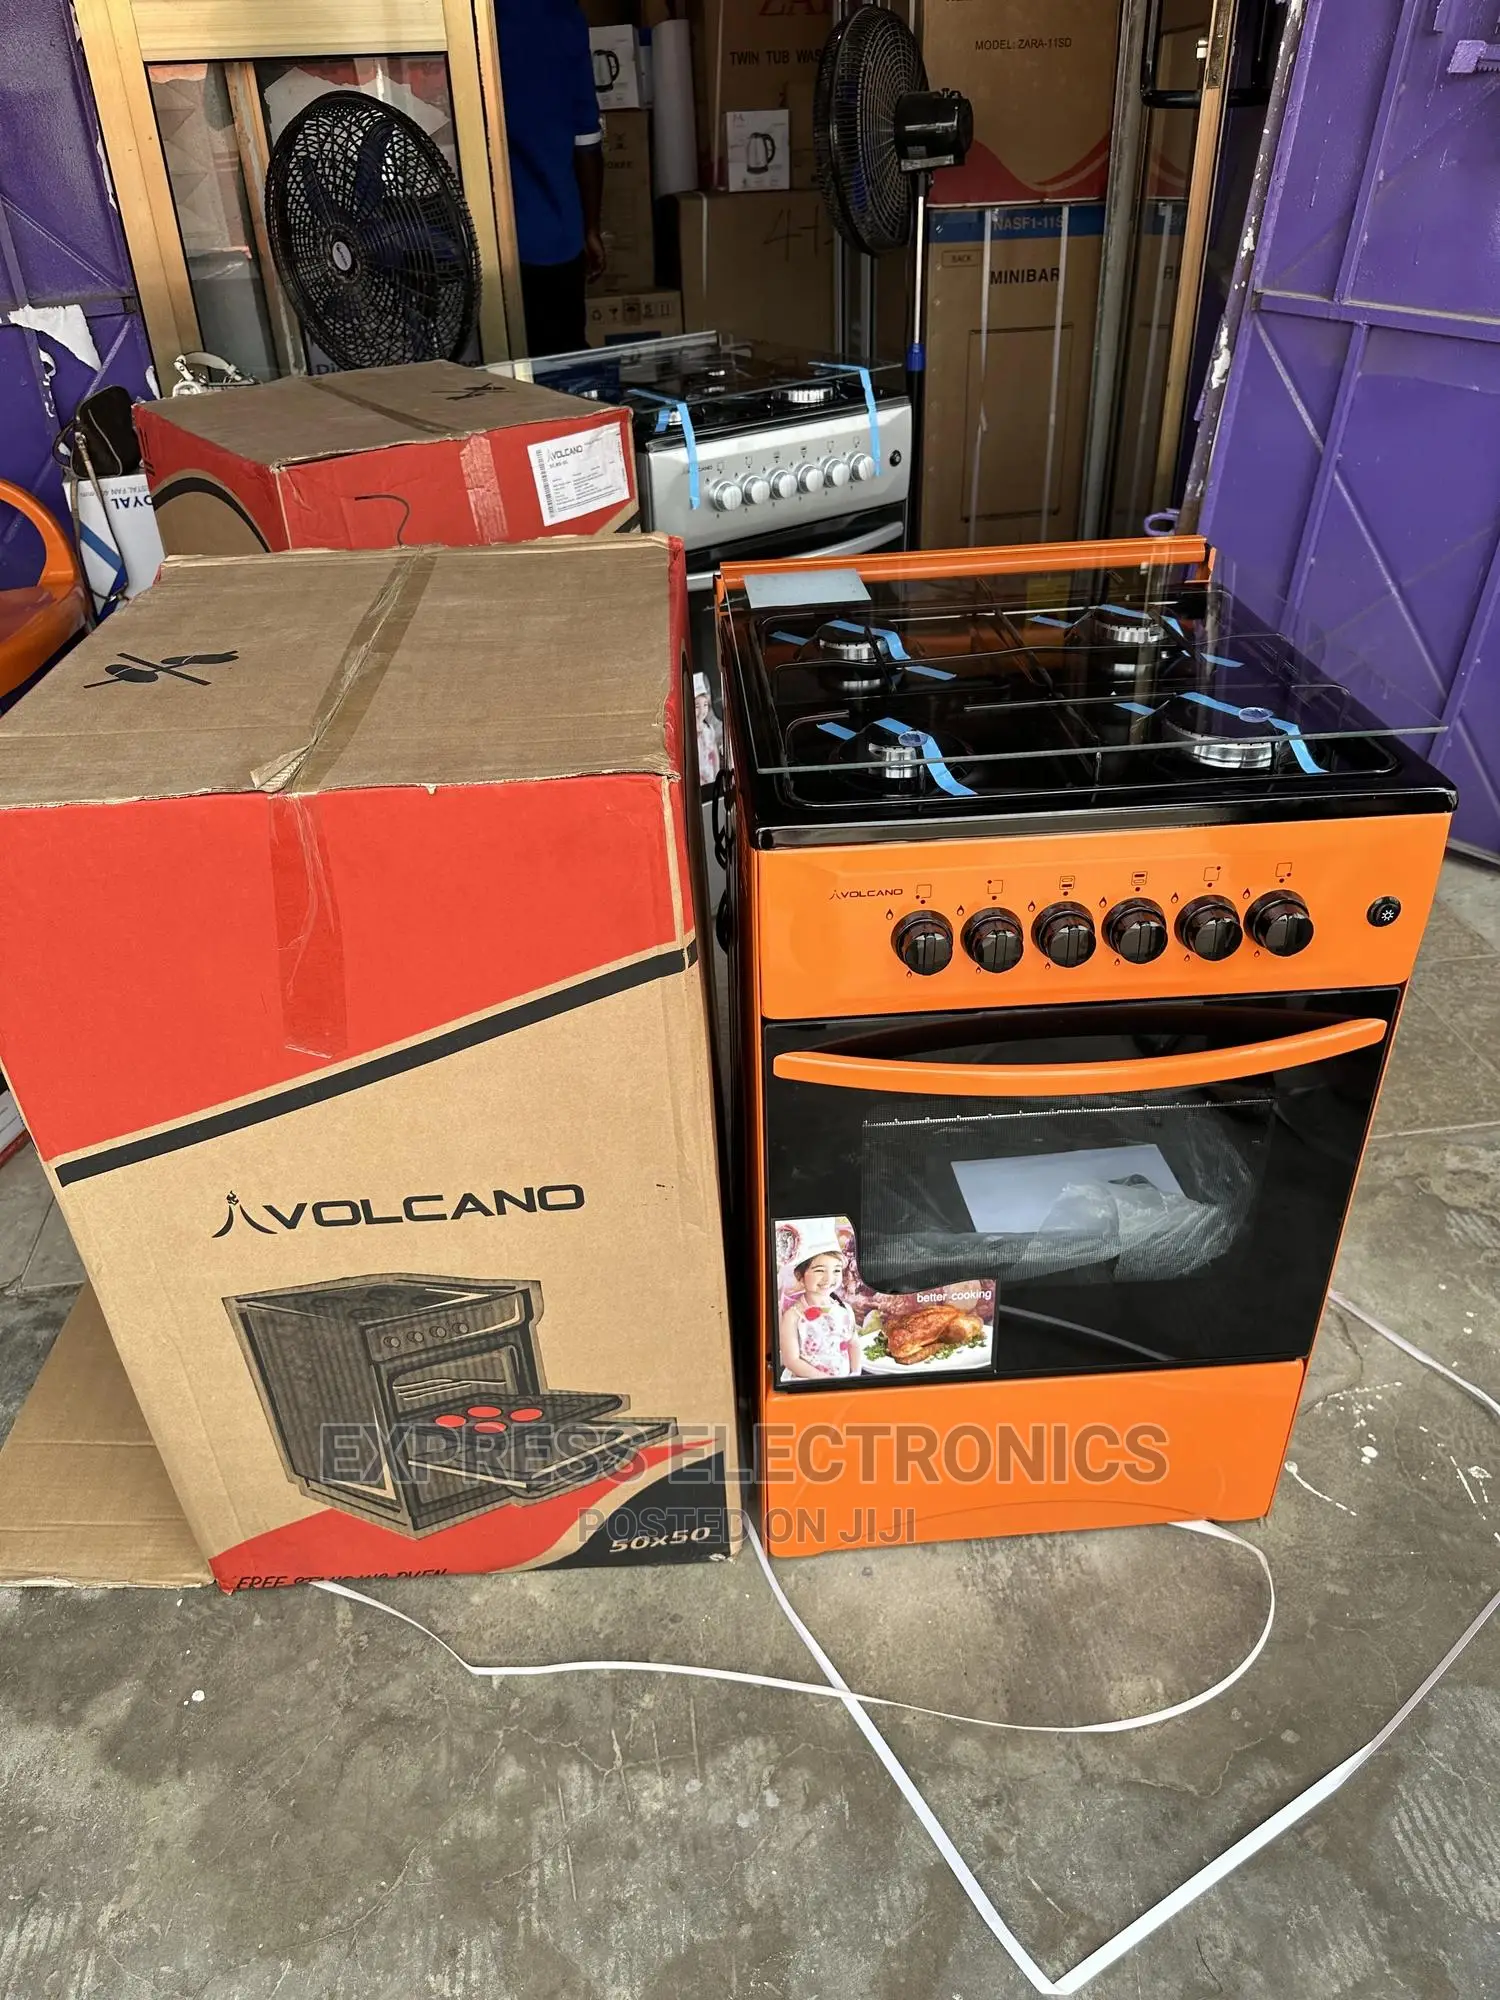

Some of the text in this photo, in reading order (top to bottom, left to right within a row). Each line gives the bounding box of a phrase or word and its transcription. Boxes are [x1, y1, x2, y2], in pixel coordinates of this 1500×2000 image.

[975, 37, 1072, 51] MODEL: ZARA-11SD
[730, 50, 760, 66] TWIN
[766, 49, 790, 65] TUB
[951, 254, 973, 264] BACK
[990, 268, 1060, 285] MINIBAR
[551, 445, 583, 460] VOLCANO
[840, 888, 903, 899] VOLCANO
[262, 1184, 585, 1230] VOLCANO
[916, 1289, 992, 1303] better cooking
[609, 1527, 711, 1553] 50x50
